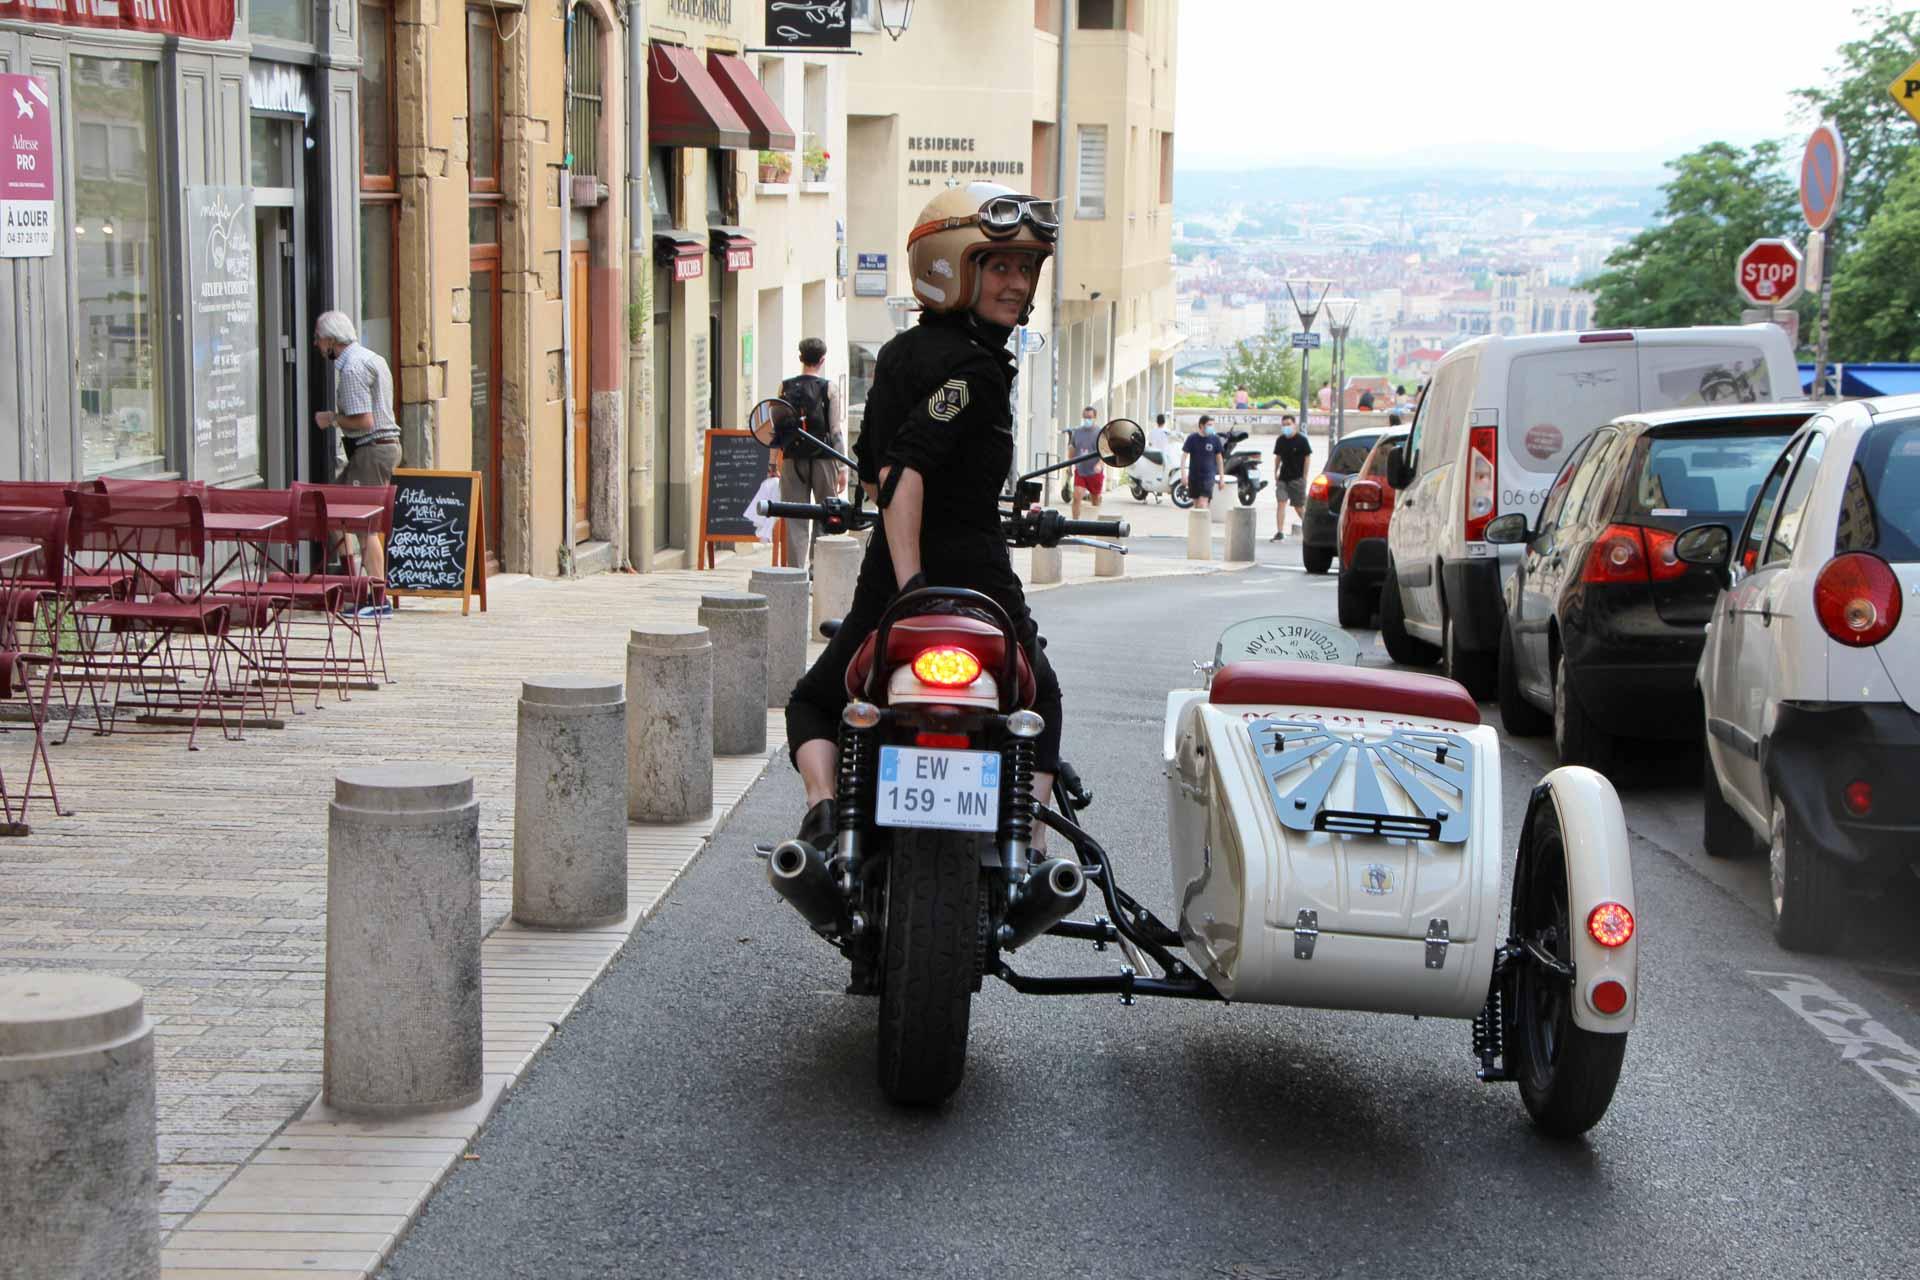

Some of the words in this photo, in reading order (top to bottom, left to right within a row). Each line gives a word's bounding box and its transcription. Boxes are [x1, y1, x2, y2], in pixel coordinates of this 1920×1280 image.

[12, 134, 38, 151] Adresse
[908, 137, 975, 151] RESIDENCE
[16, 154, 36, 170] PRO
[908, 160, 948, 173] ANDRE
[952, 161, 1024, 176] DUPASQUIER
[8, 206, 14, 226] À
[17, 211, 48, 226] LOUER
[1745, 263, 1794, 282] STOP
[1503, 489, 1525, 506] 06
[395, 532, 457, 545] GRANDE
[915, 756, 949, 780] EW
[888, 786, 935, 812] 159
[957, 791, 987, 816] MN
